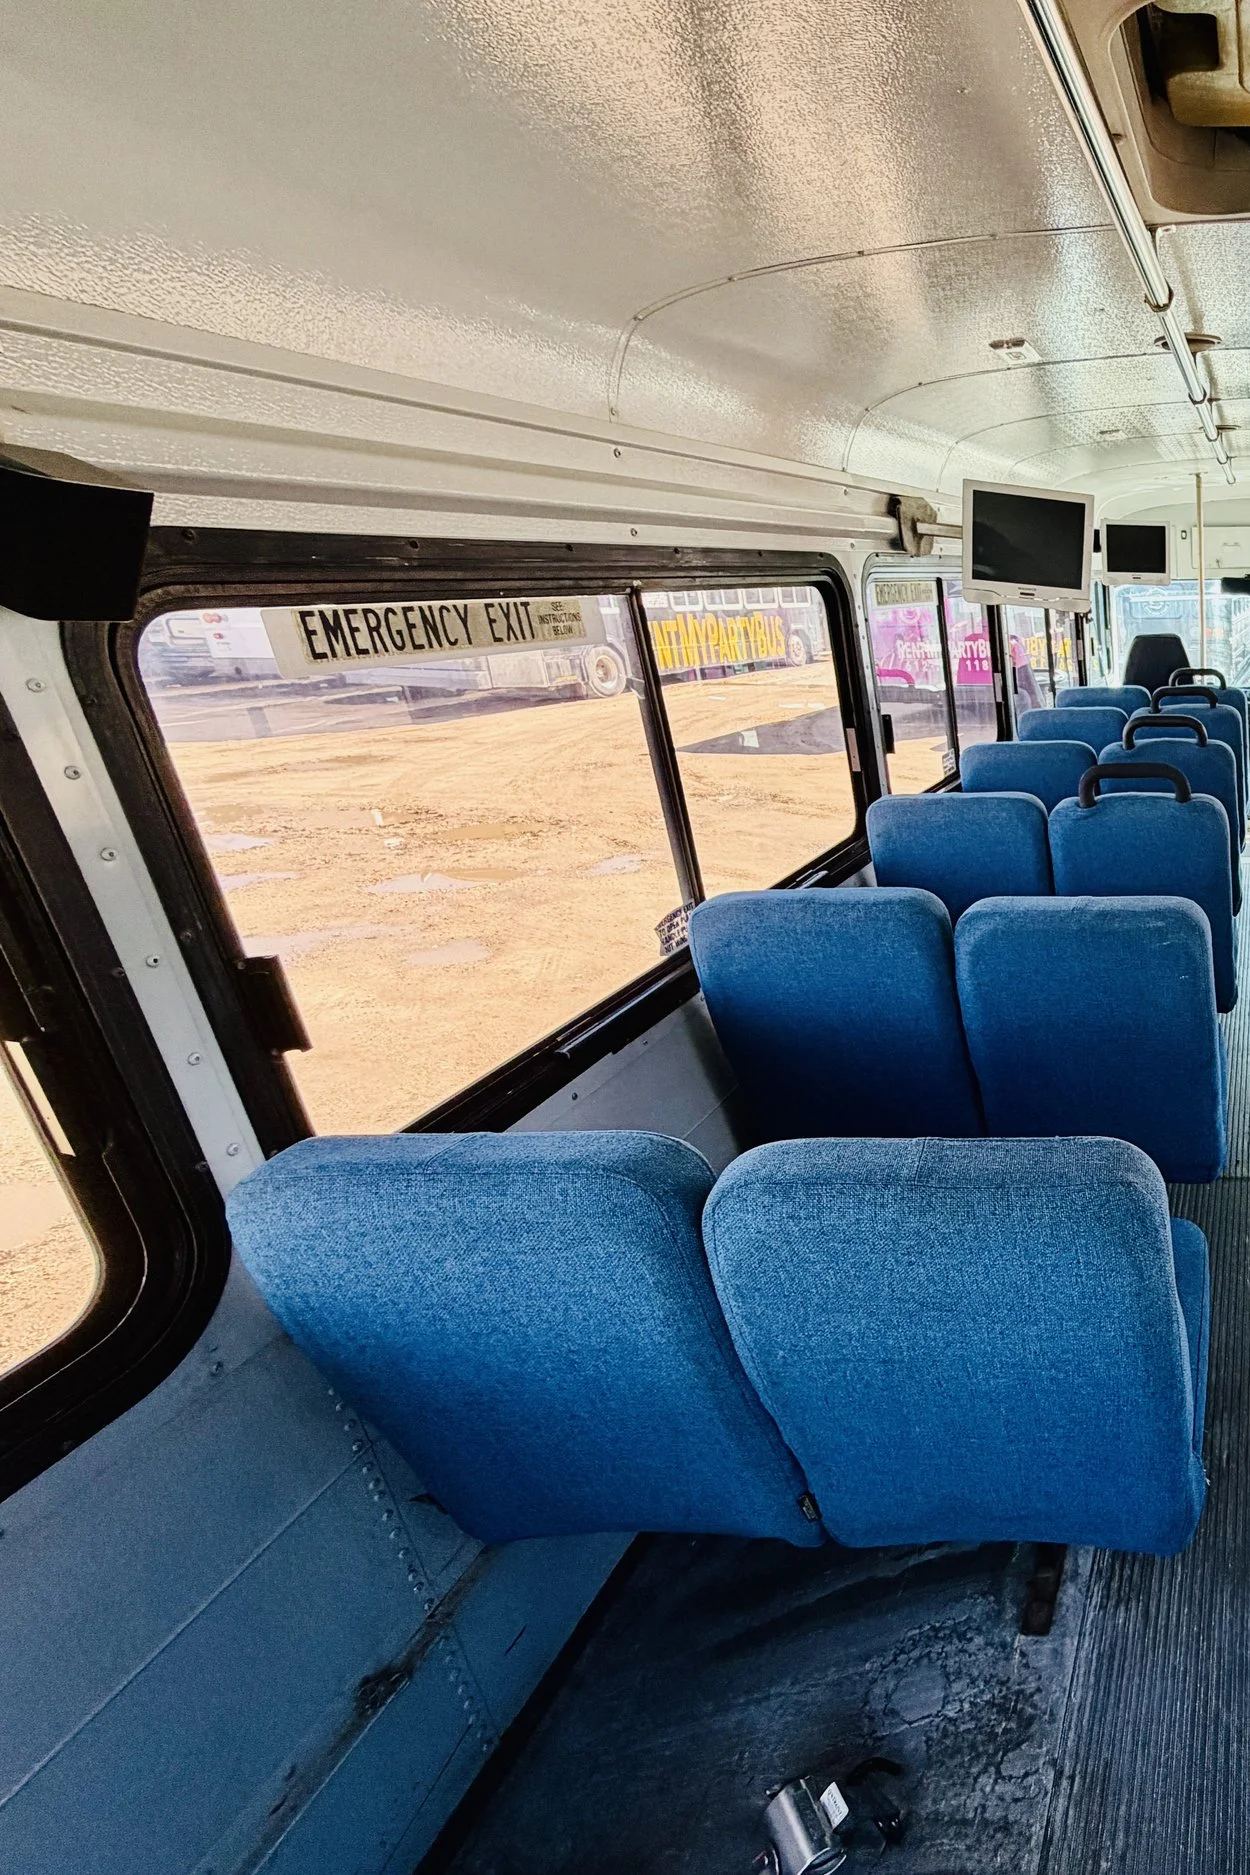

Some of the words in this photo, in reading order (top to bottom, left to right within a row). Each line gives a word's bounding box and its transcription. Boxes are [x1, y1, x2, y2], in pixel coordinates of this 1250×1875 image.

[551, 601, 564, 611] SEE
[299, 603, 473, 660] EMERGENCY
[484, 601, 535, 643] EXIT
[552, 625, 573, 636] BELOW
[648, 612, 786, 671] NTMYPARTYBUS
